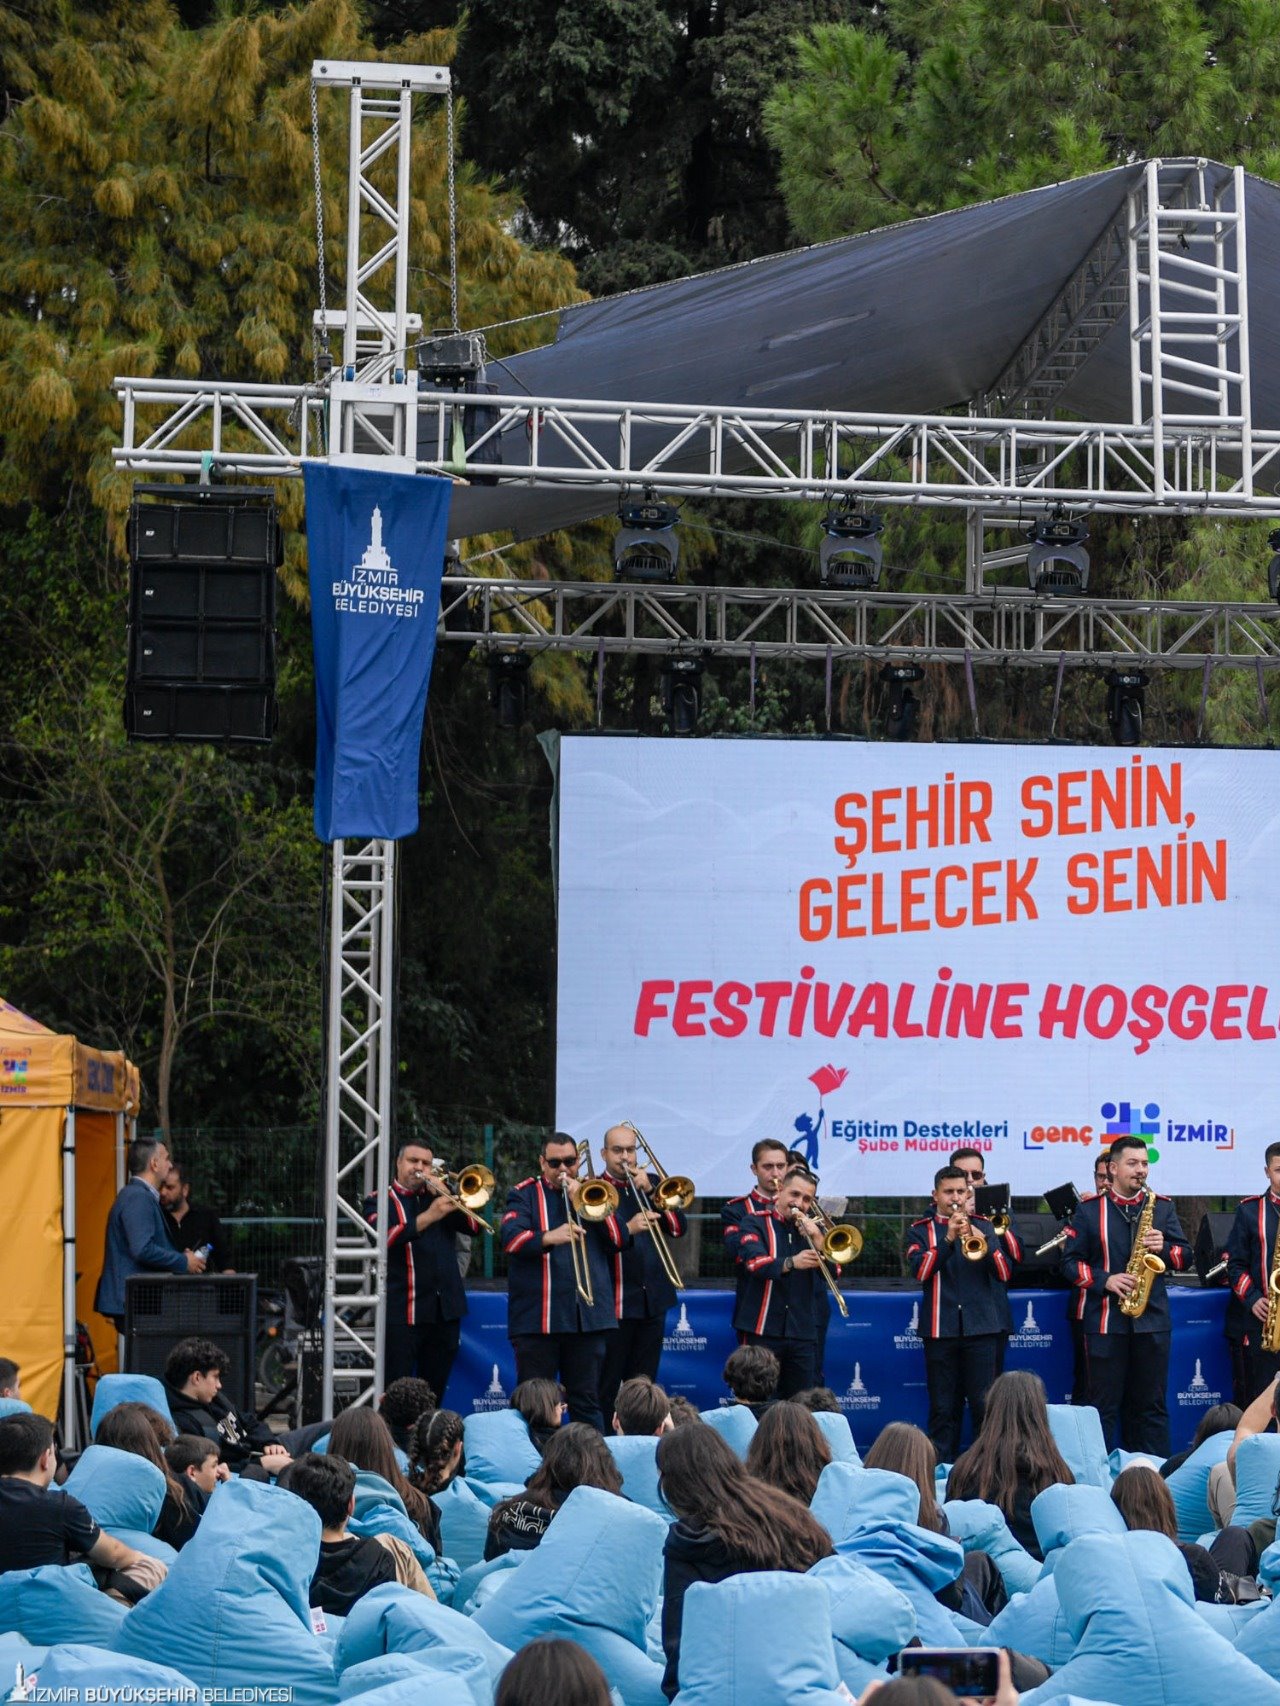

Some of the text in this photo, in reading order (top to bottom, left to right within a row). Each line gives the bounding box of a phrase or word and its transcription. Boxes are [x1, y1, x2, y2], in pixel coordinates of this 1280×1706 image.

[352, 568, 398, 585] İZMİR
[332, 580, 424, 603] BÜYÜKŞEHİR
[834, 754, 1196, 869] ŞEHİR SENİN,
[799, 832, 1227, 942] GELECEK SENİN
[634, 965, 1030, 1038] FESTİVALİNE
[831, 1120, 1008, 1142] Eğitim Destekleri
[1167, 1119, 1228, 1142] İZMİR
[858, 1138, 993, 1155] Şube Müdürlüğü
